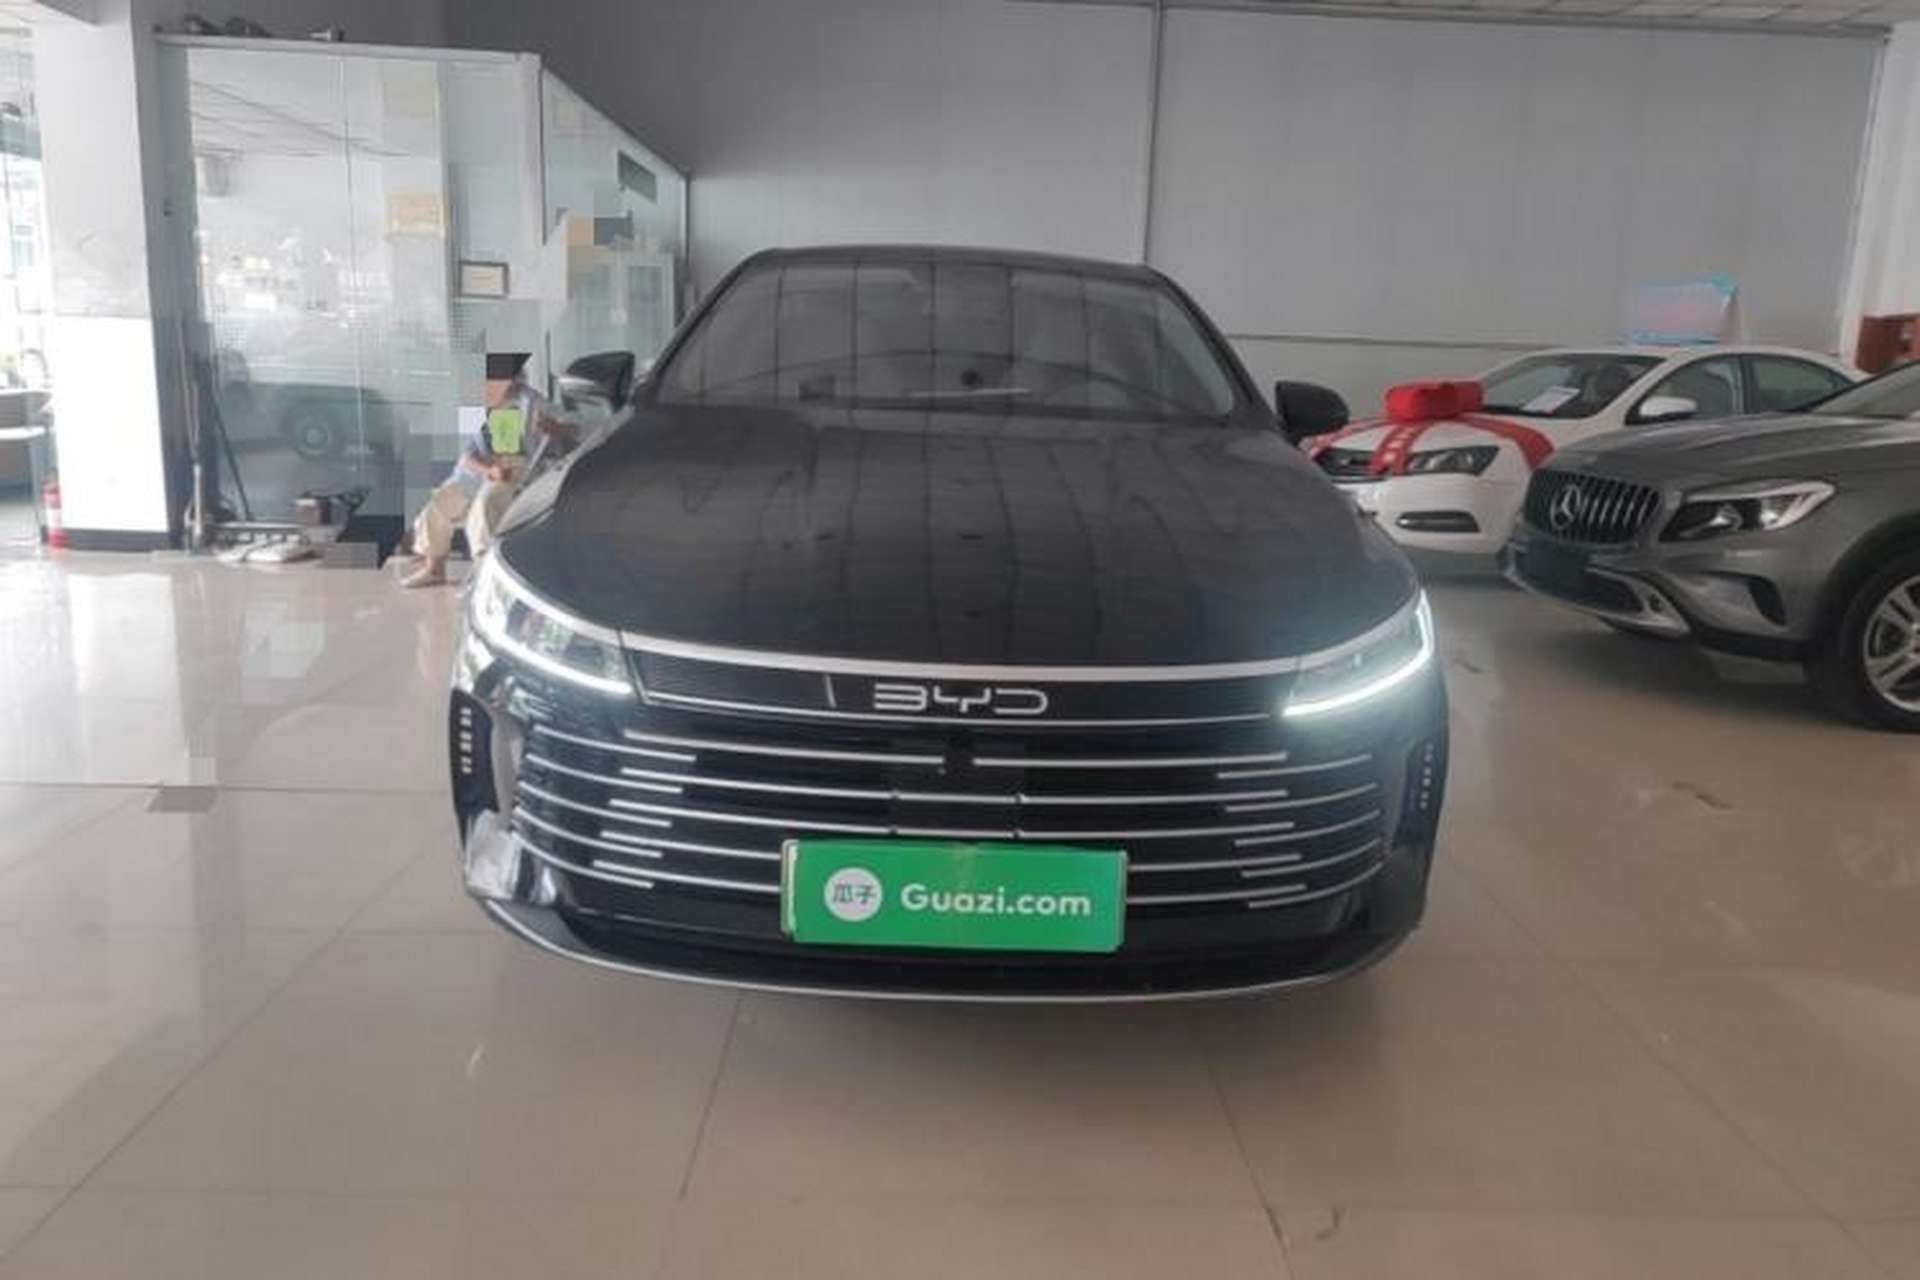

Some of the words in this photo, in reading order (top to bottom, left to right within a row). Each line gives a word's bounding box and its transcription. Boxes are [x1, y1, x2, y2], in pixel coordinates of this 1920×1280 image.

[874, 683, 1048, 714] BYD
[833, 883, 877, 906] 瓜子
[901, 883, 1091, 915] Guazi.com
